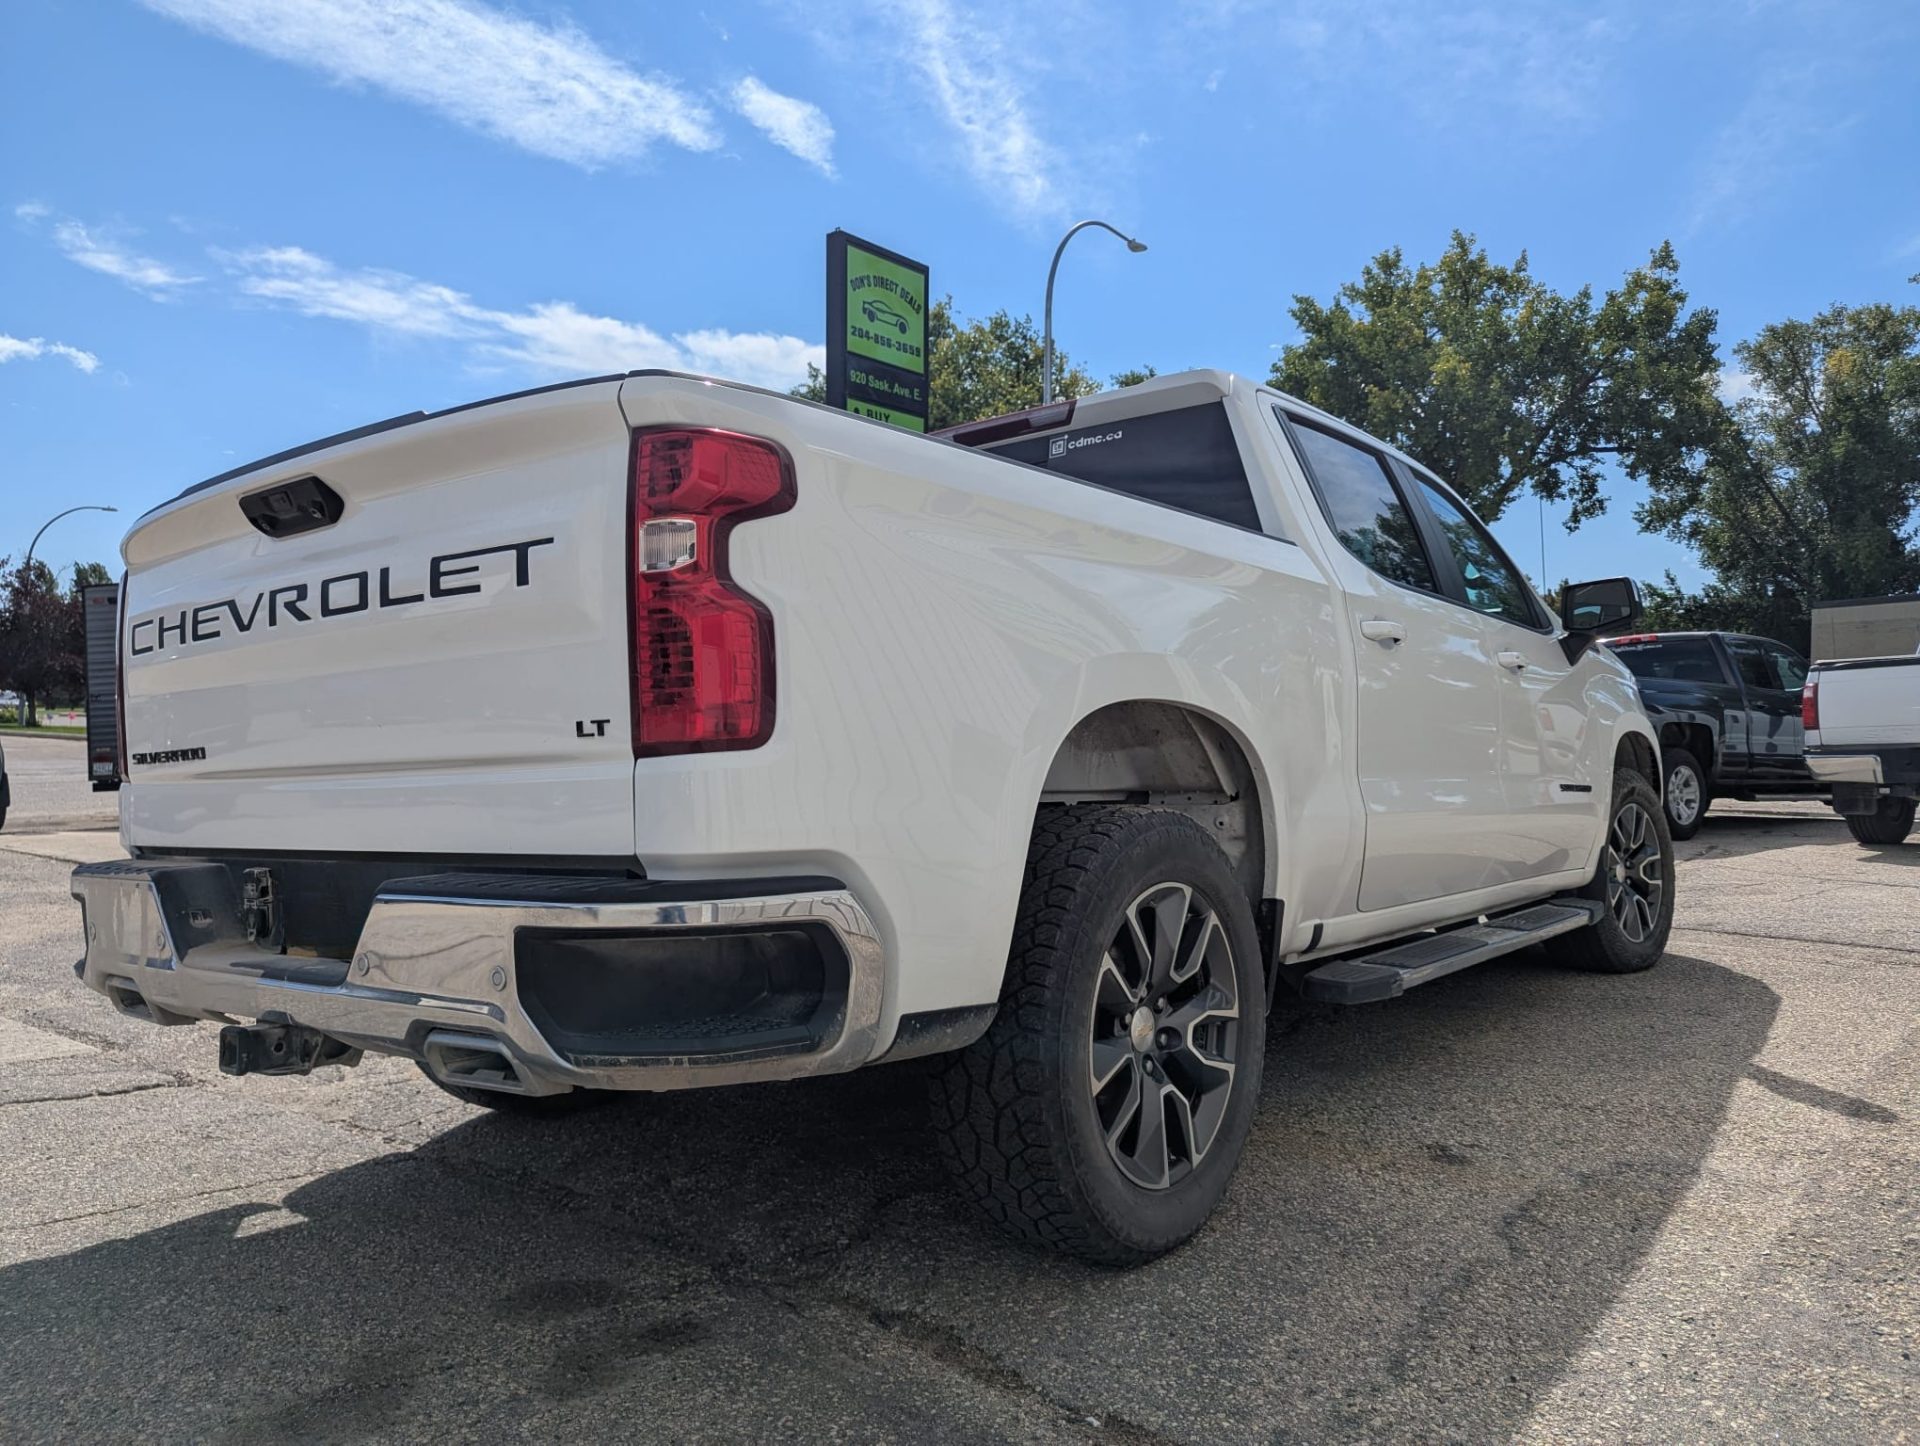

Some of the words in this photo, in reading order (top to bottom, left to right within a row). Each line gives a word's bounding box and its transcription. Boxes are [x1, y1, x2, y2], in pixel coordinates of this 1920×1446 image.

[850, 274, 872, 291] DON'S
[872, 275, 899, 294] DIRECT
[900, 287, 922, 315] DEALS
[850, 370, 867, 385] 920
[868, 375, 892, 393] Sask.
[892, 383, 912, 399] Ave.
[1067, 430, 1123, 449] cdmc.ca
[131, 537, 555, 656] CHEVROLET
[576, 719, 611, 738] LT
[132, 746, 206, 765] SILVERADO
